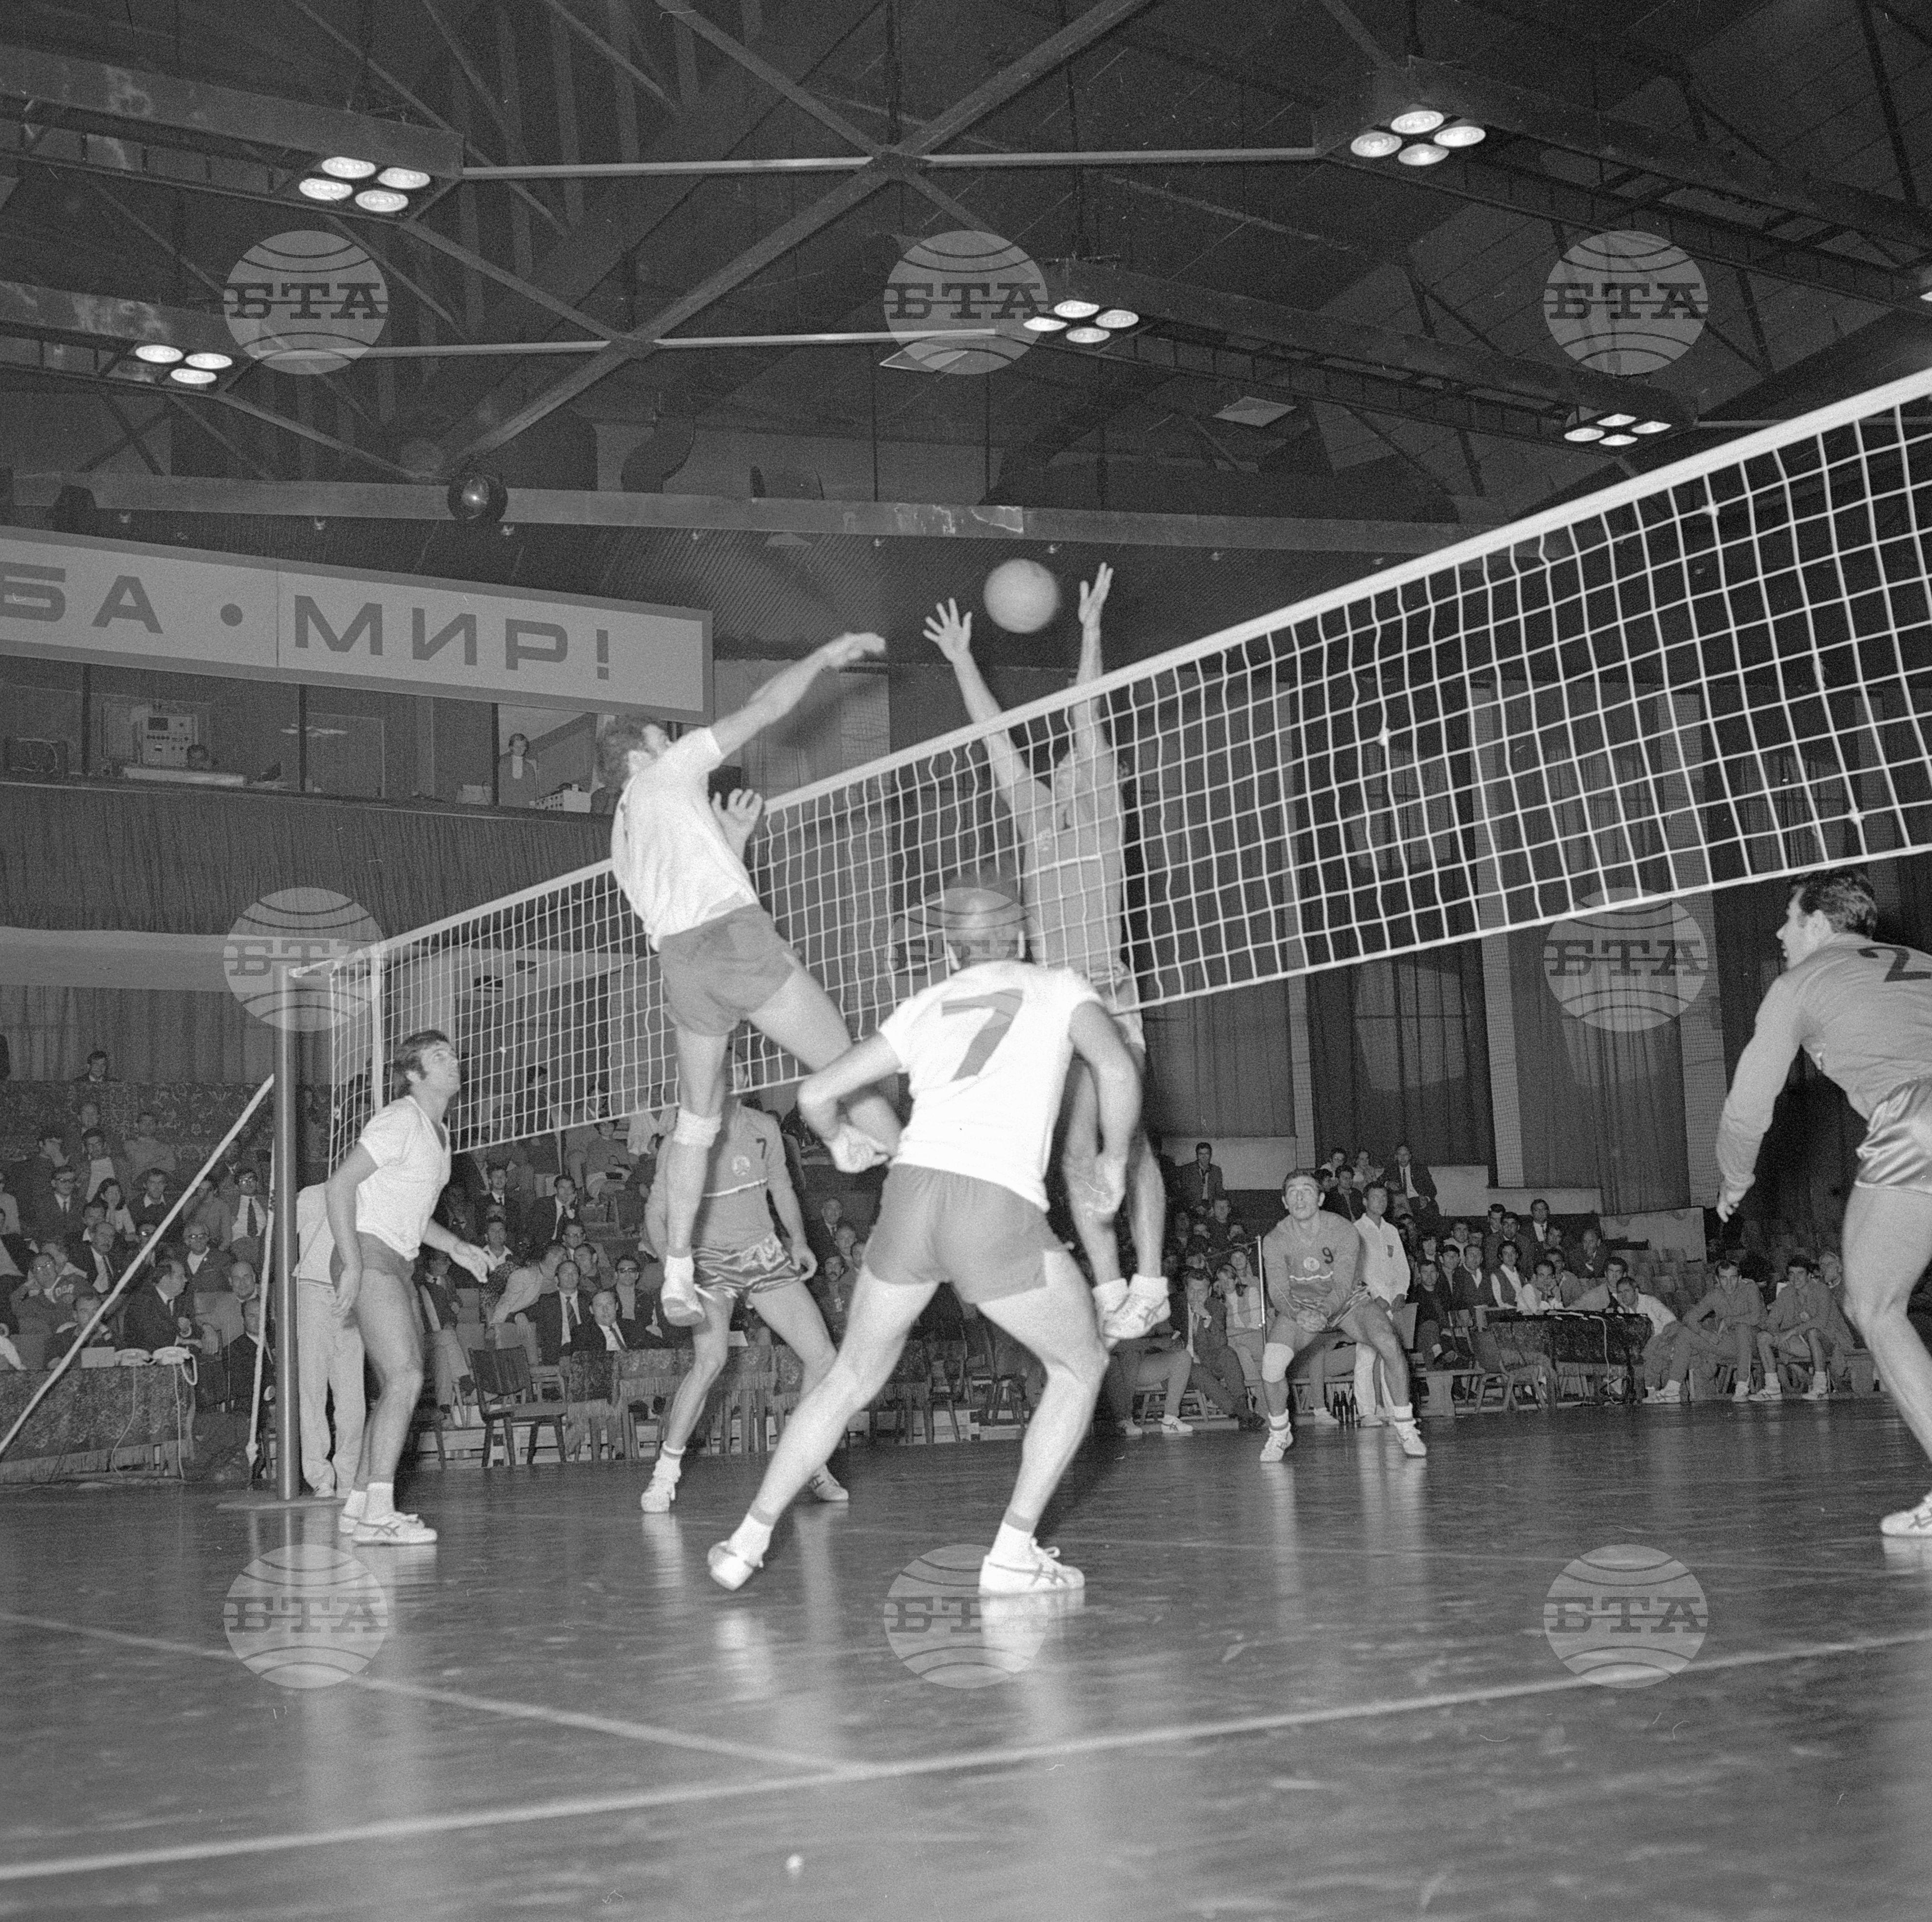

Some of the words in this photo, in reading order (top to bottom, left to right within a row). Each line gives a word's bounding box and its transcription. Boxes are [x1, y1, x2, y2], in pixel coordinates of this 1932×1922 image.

[0, 561, 163, 634] БА
[295, 595, 609, 680] МИР!
[1857, 946, 1932, 982] 2
[941, 988, 1023, 1082] 7
[755, 1138, 767, 1160] 7
[1322, 1247, 1334, 1264] 9
